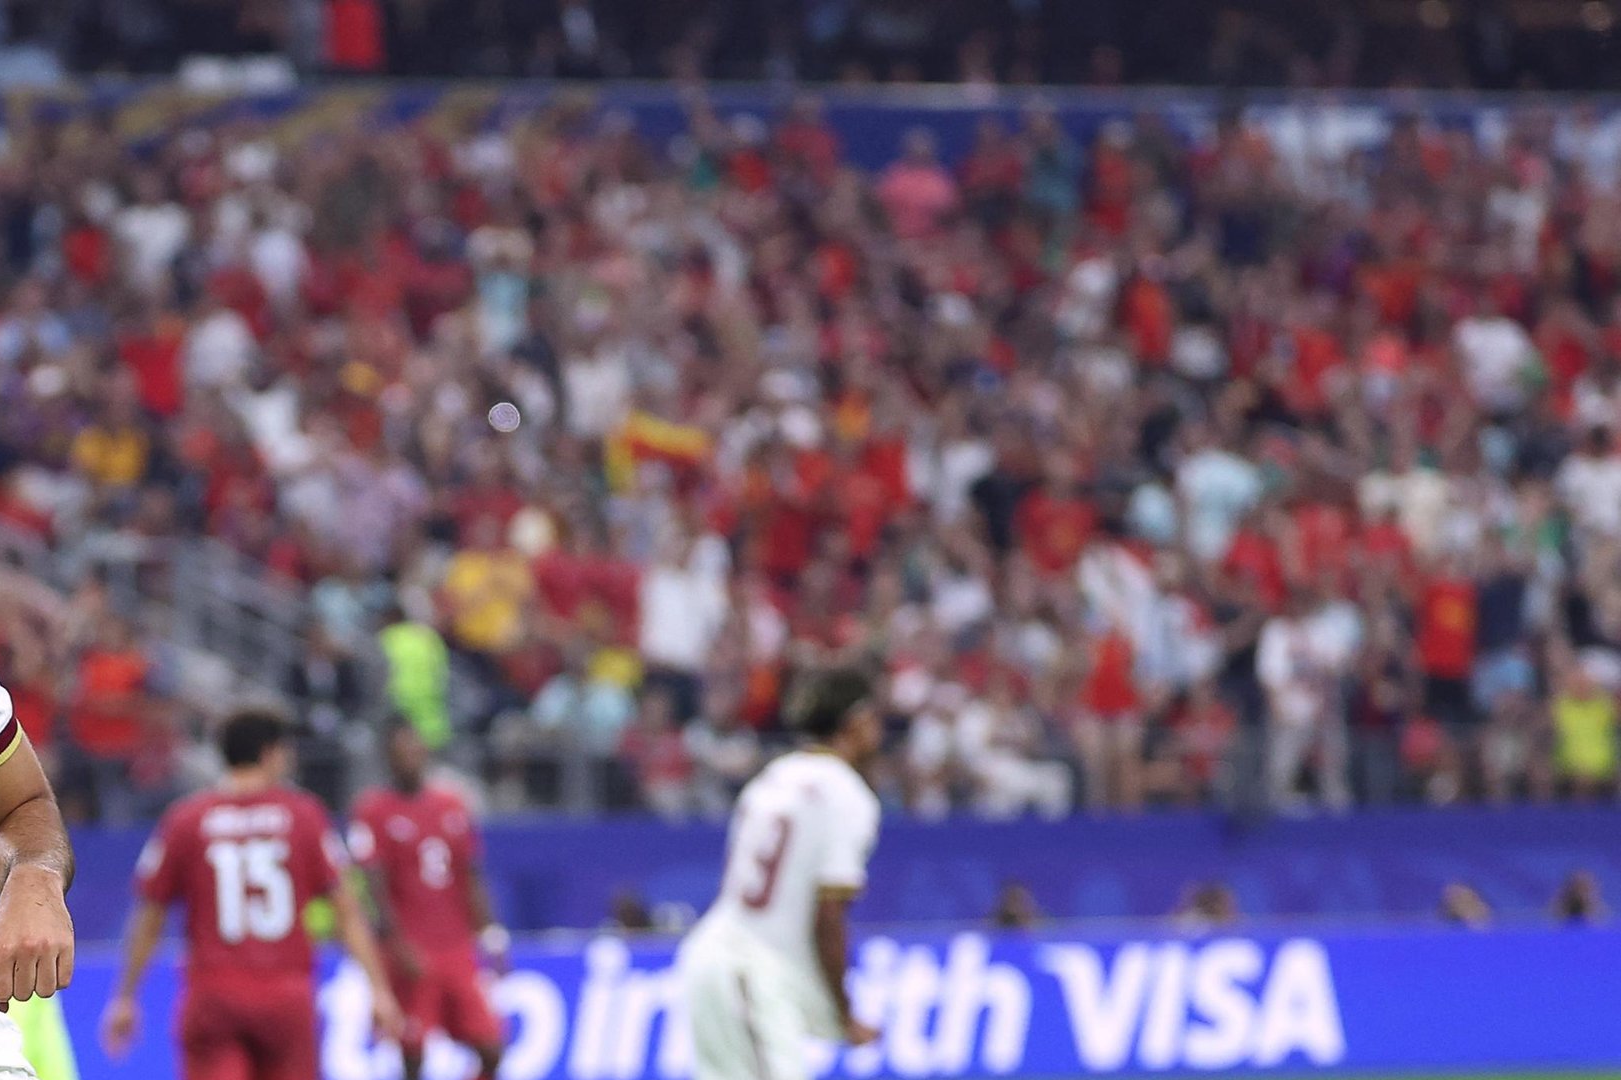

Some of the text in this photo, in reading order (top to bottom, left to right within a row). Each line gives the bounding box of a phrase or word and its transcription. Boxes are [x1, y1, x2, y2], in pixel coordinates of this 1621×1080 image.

[206, 838, 295, 943] 15
[800, 932, 1032, 1080] ith
[1036, 938, 1347, 1070] VISA
